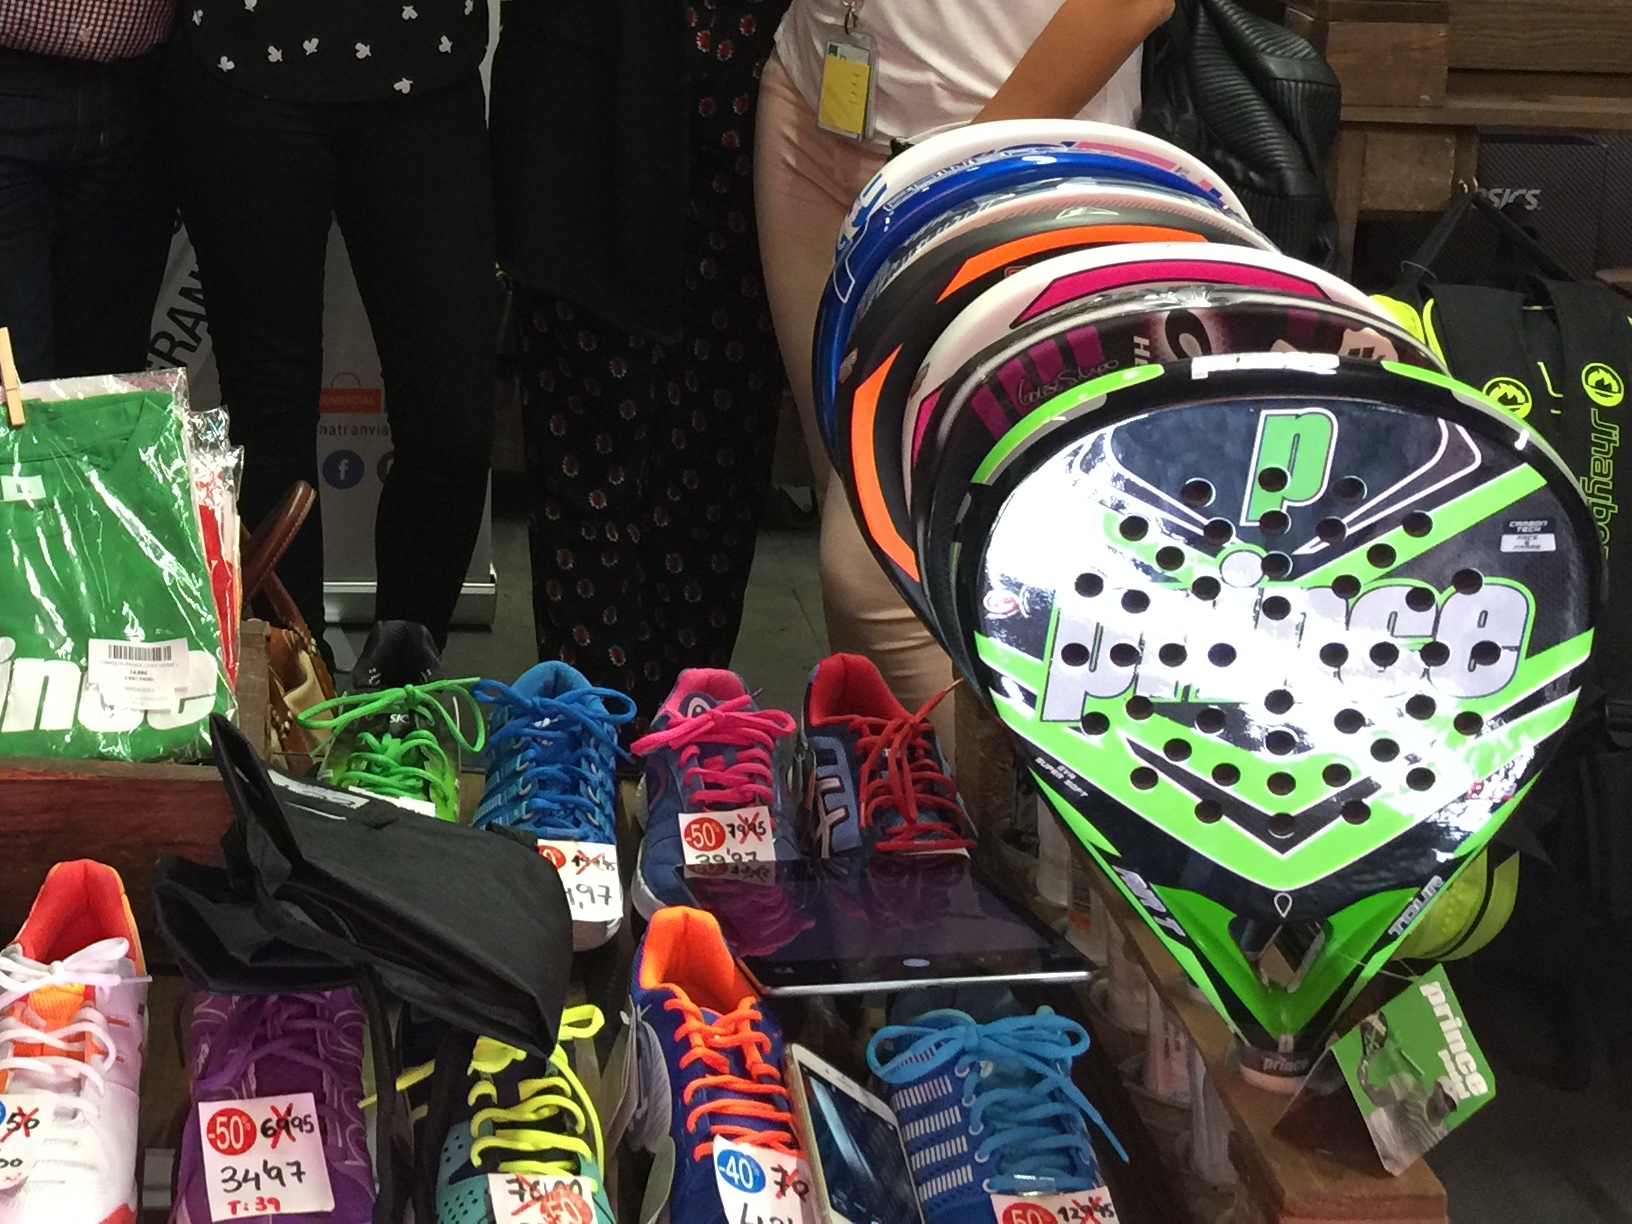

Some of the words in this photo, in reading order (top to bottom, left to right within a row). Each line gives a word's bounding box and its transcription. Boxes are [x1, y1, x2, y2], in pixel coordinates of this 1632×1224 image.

[320, 395, 376, 407] OMERCIAL
[1040, 574, 1540, 724] prce
[1387, 874, 1445, 938] TOUR
[1418, 979, 1490, 1098] prince
[220, 1158, 307, 1194] 34'97
[254, 1195, 282, 1213] 39
